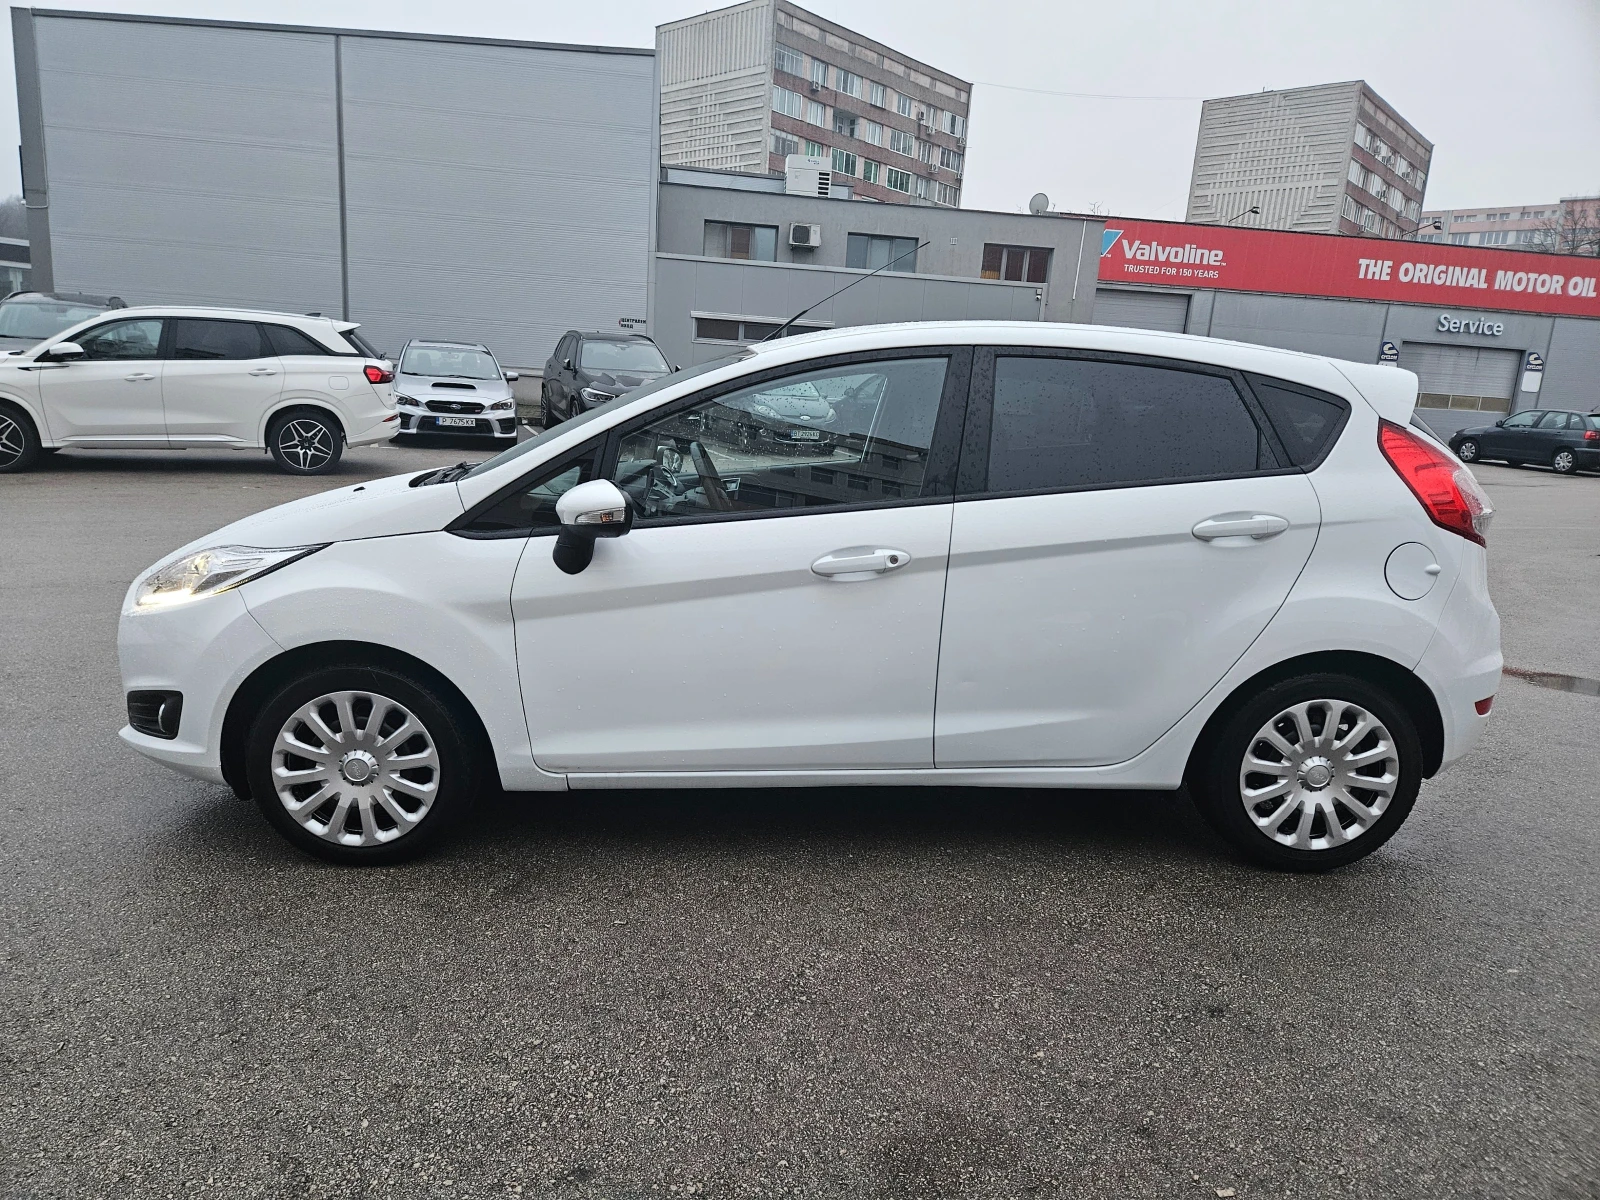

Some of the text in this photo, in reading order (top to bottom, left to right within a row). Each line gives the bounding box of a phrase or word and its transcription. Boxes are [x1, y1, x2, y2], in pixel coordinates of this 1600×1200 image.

[1122, 239, 1223, 265] Valvoline
[1124, 264, 1219, 279] TRUSTED FOR 150 YEARS
[1358, 258, 1597, 298] THE ORIGINAL MOTOR OIL
[1437, 313, 1504, 336] Service
